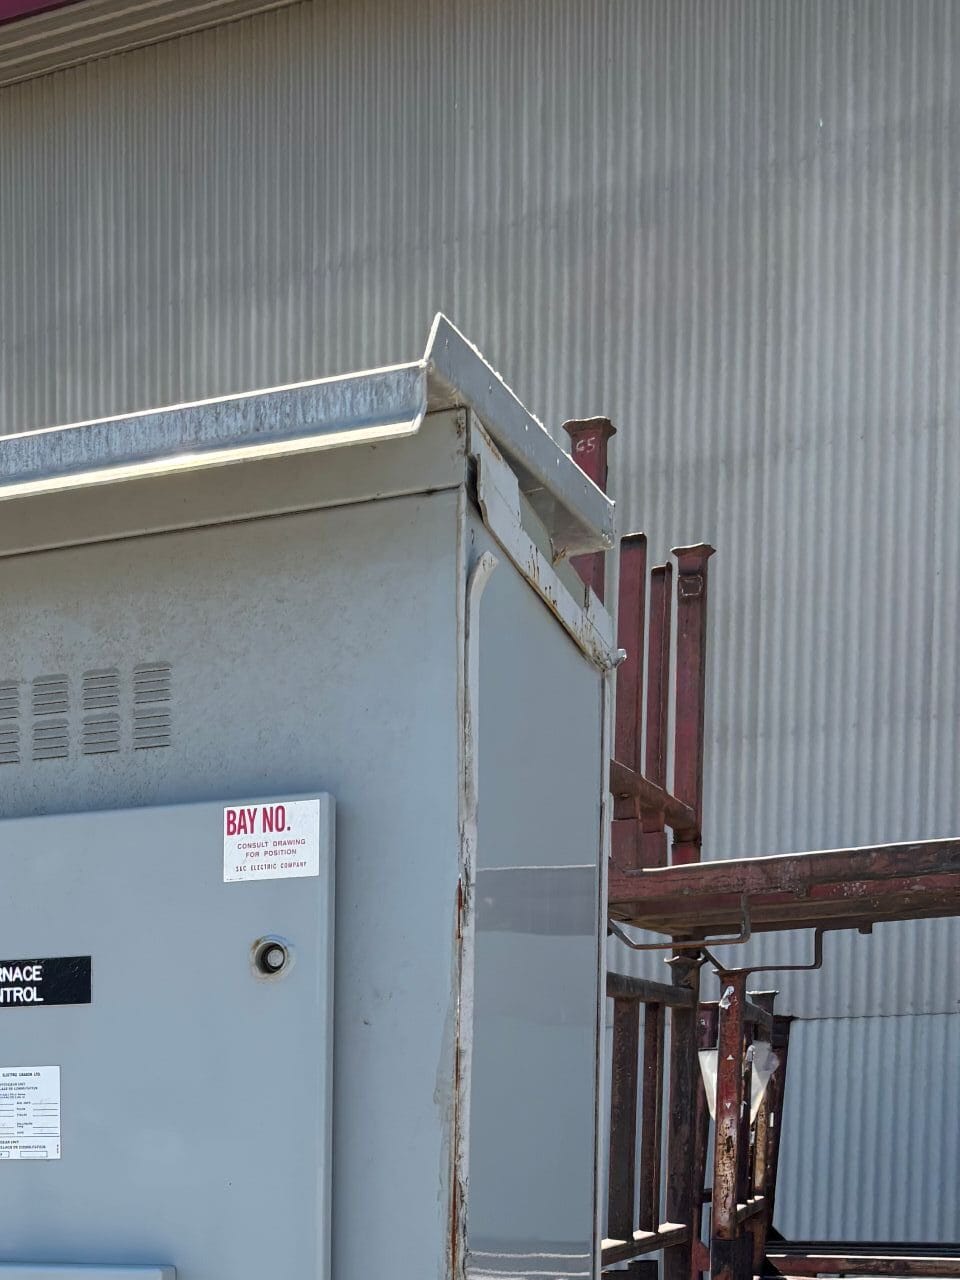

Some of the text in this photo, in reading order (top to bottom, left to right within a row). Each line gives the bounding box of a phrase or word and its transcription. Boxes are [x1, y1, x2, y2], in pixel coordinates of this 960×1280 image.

[226, 805, 291, 836] BAY NO.
[237, 838, 306, 850] CONSULT DRAWING
[263, 848, 297, 857] POSITION
[250, 863, 277, 871] ELECTRIC
[280, 861, 307, 869] COMPANY
